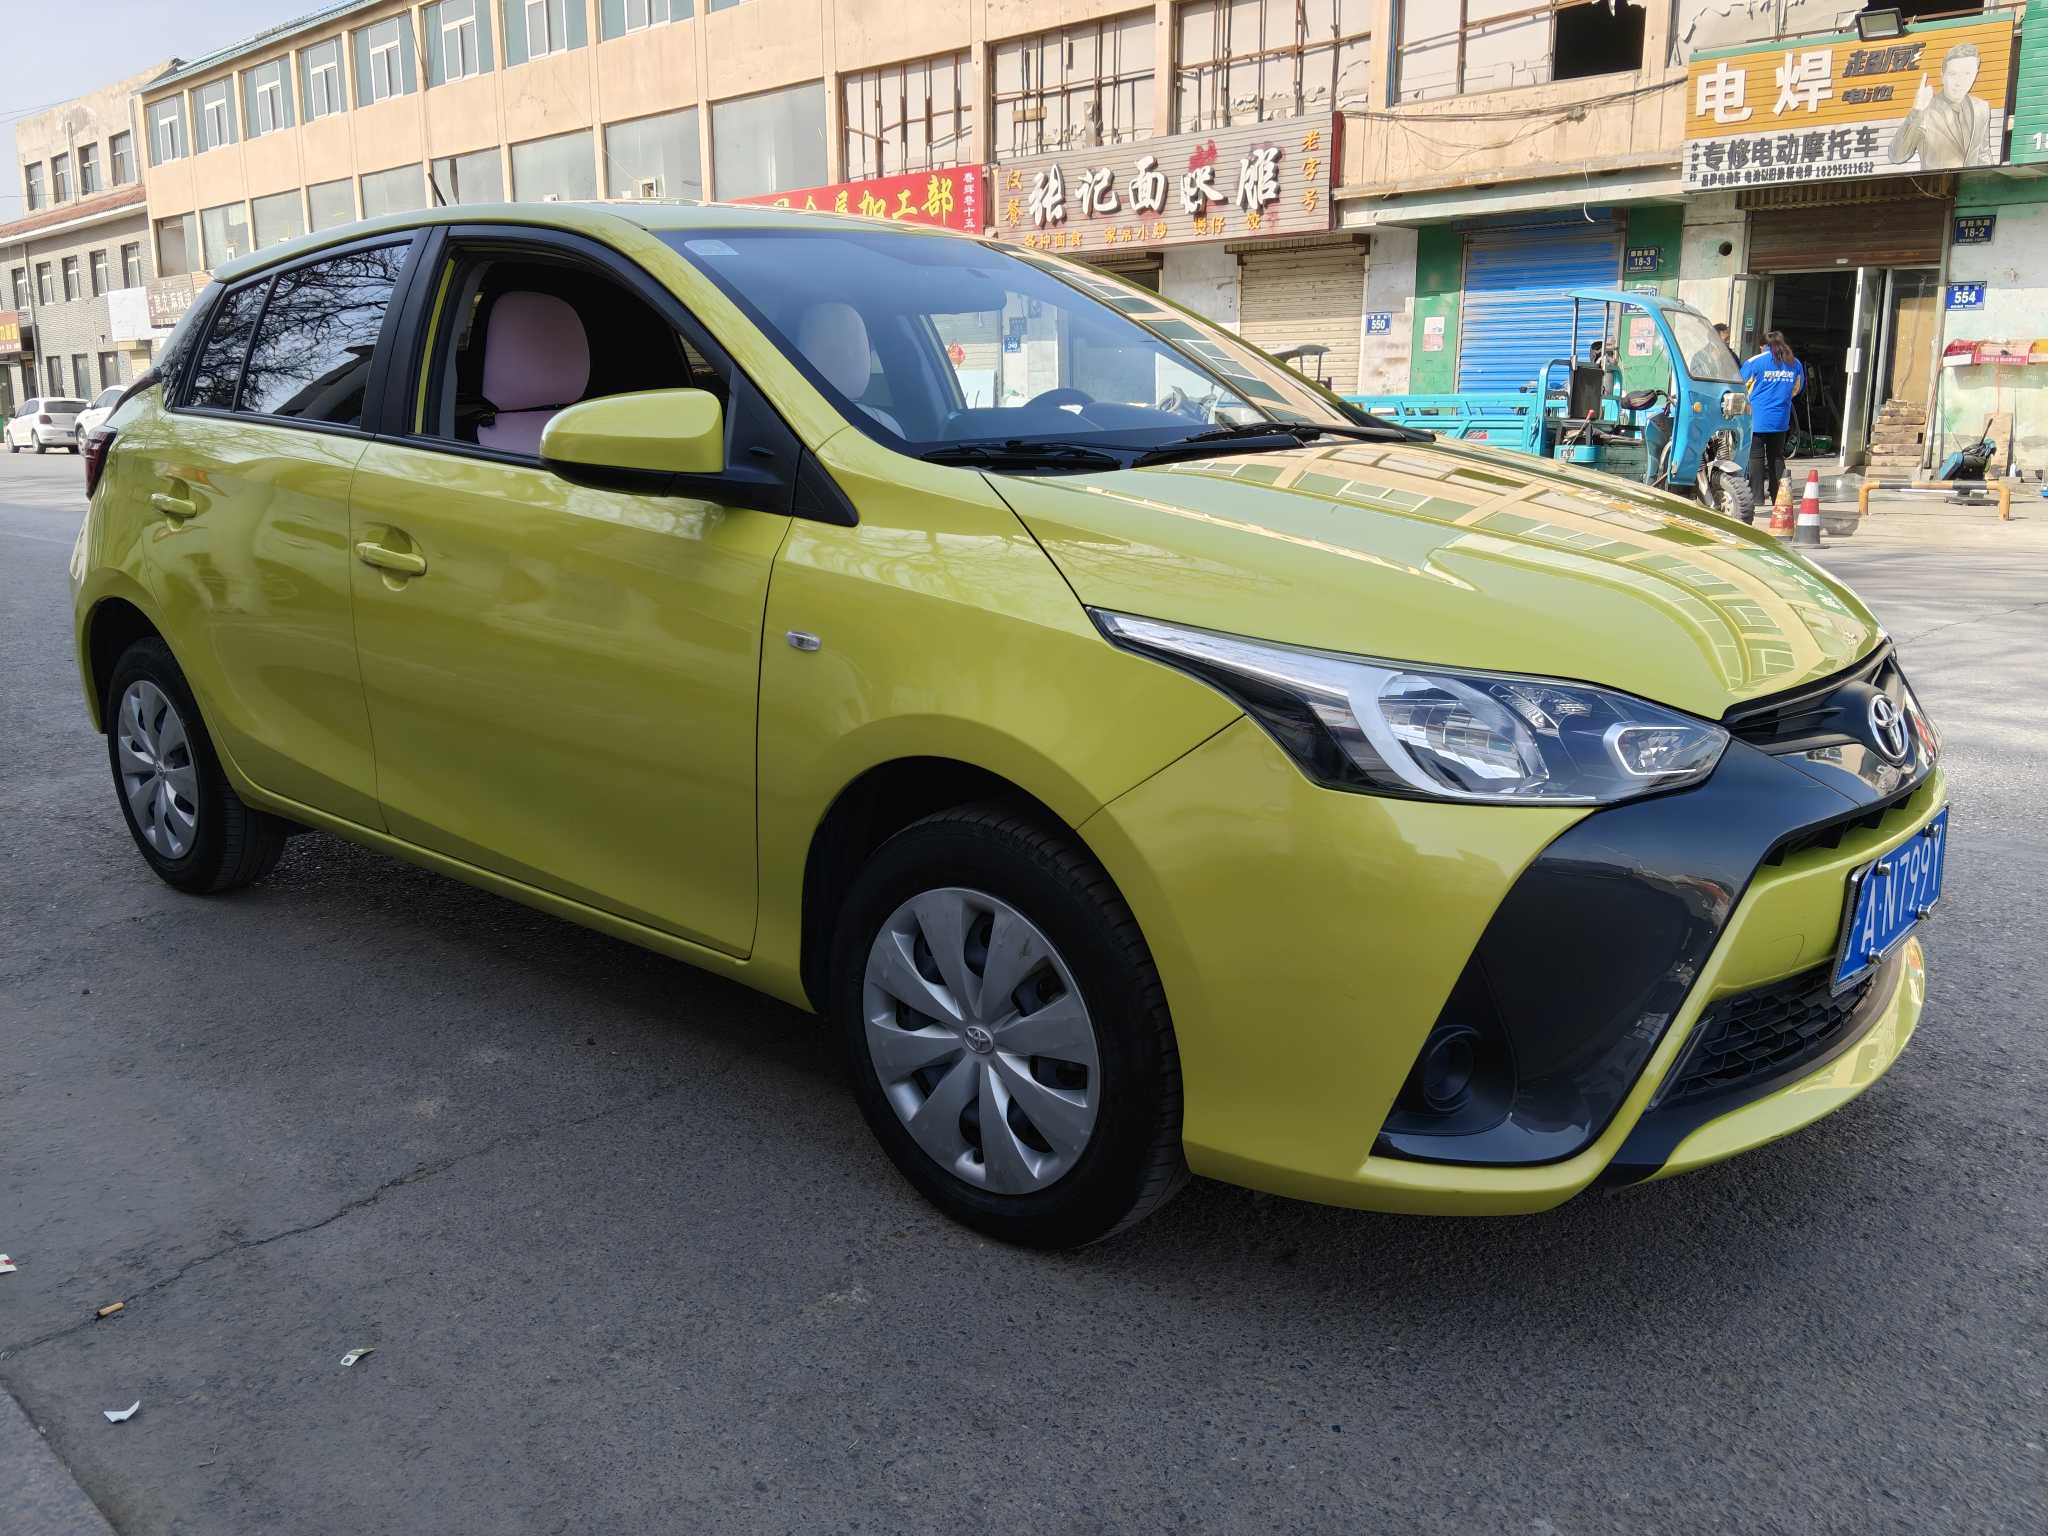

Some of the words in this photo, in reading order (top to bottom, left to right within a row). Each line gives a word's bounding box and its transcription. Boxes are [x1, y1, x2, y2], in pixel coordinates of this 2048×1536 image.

[1695, 49, 1833, 124] 电焊
[1703, 126, 1879, 171] 专修电动摩托车
[1302, 128, 1320, 212] 老字号
[1964, 227, 1985, 238] 18-2
[1634, 256, 1651, 266] 18-3
[1954, 291, 1976, 304] 554
[1371, 319, 1386, 330] 550
